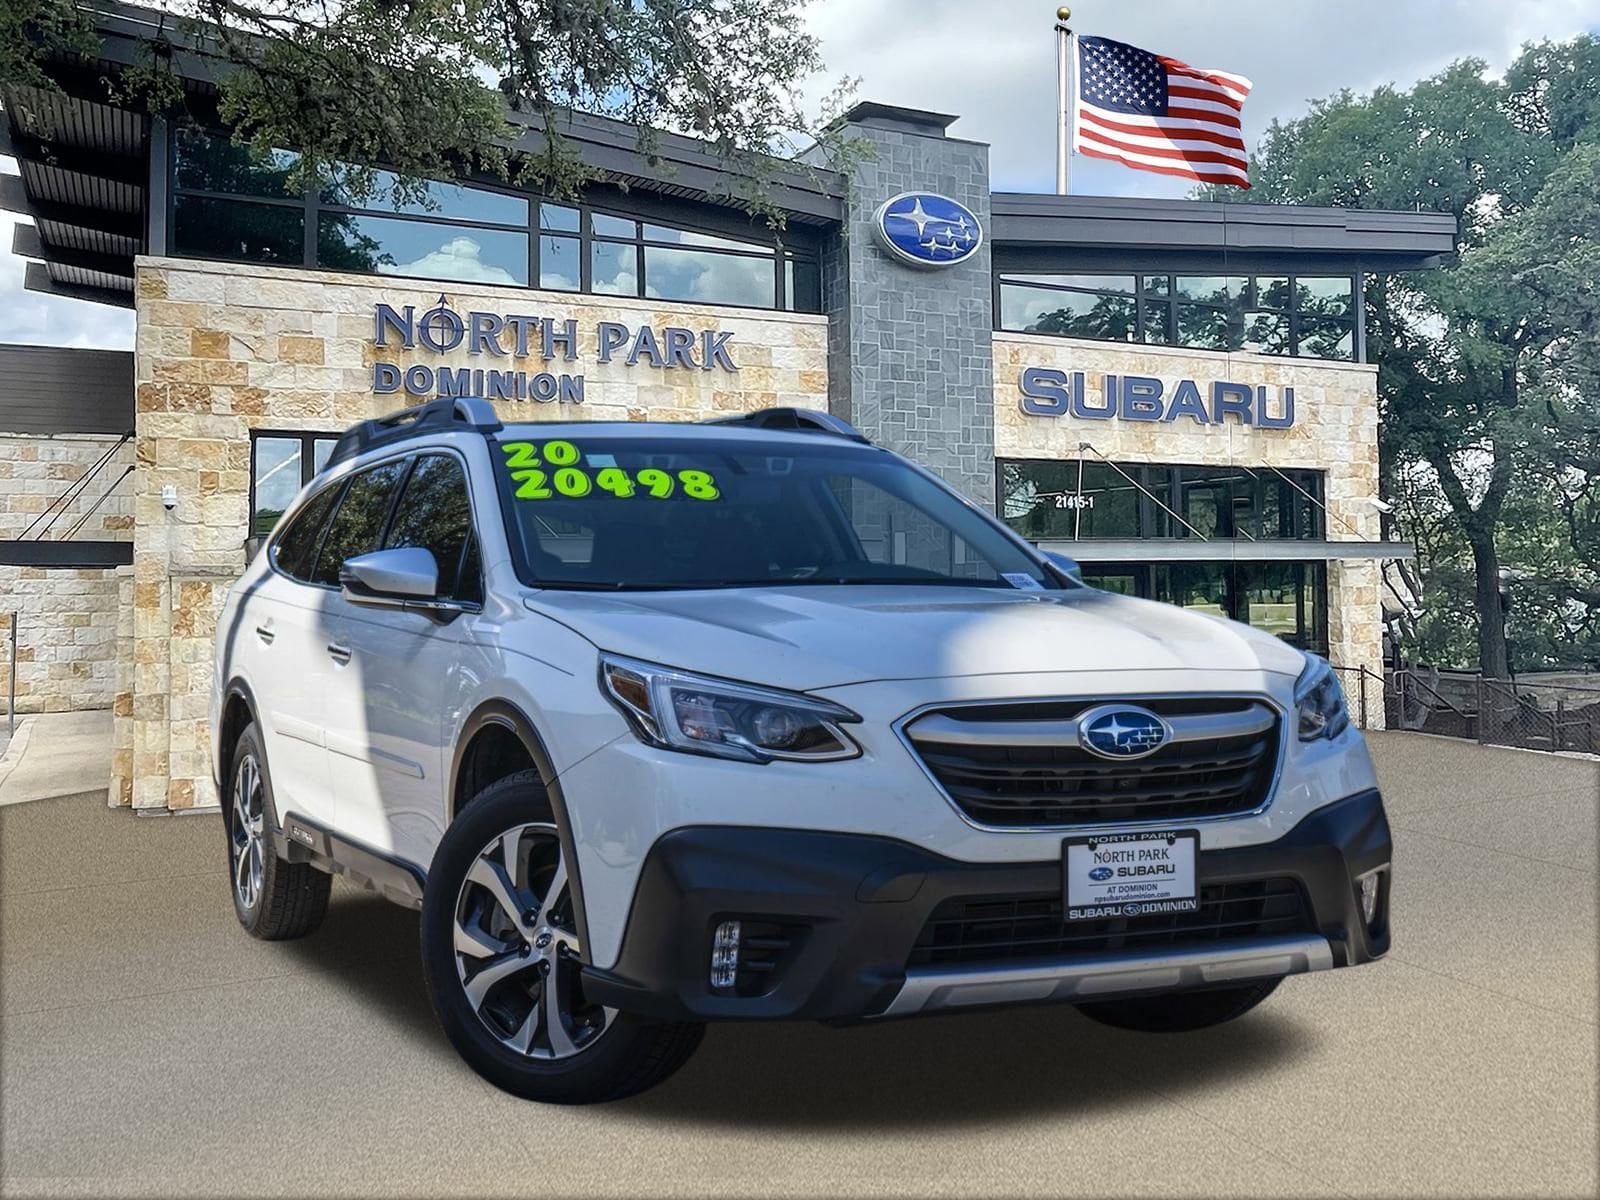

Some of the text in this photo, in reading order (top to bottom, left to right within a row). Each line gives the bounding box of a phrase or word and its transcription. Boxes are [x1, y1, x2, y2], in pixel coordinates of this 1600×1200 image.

[375, 299, 742, 373] NORTH PARK
[373, 362, 585, 404] DOMINION
[1019, 367, 1296, 430] SUBARU
[502, 440, 581, 468] 20
[510, 467, 720, 501] 20498
[1088, 831, 1177, 845] NORTH PARK
[1094, 847, 1171, 864] NORTH PARK
[1117, 864, 1175, 877] SUBARU
[1106, 883, 1159, 895] AT DOMINION
[1069, 900, 1197, 920] SUBARU DOMINION
